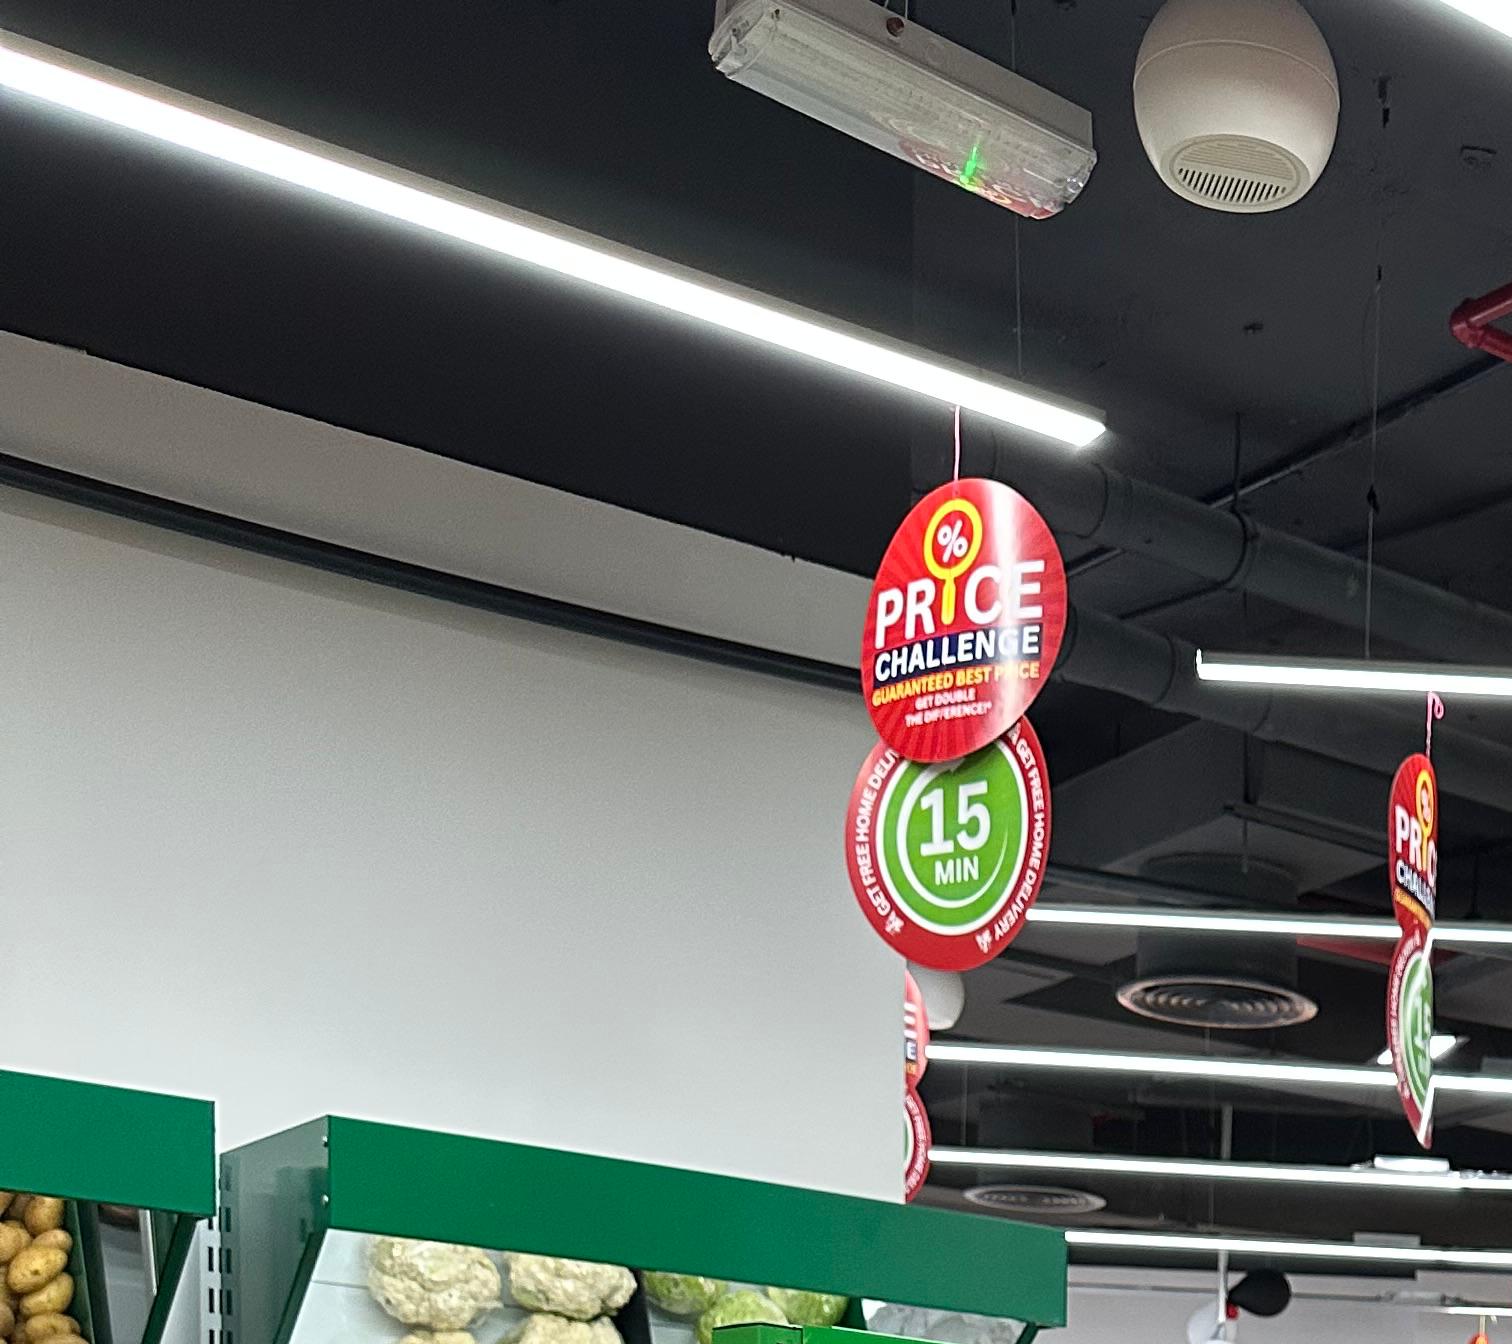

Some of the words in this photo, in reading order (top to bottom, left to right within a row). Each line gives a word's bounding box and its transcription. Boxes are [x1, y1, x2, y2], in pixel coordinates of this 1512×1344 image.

[875, 560, 1046, 649] PRICE
[875, 626, 1040, 682] CHALLENGE
[872, 673, 953, 707] GUARANTEED
[955, 666, 992, 685] BEST
[905, 710, 923, 727] THE
[1028, 767, 1044, 811] FREE
[856, 789, 877, 842] HOME
[920, 782, 990, 857] 15
[856, 843, 876, 886] FREE
[1029, 815, 1044, 871] HOME
[935, 856, 979, 886] MIN
[866, 886, 891, 917] GET
[994, 874, 1037, 941] DELIVERY
